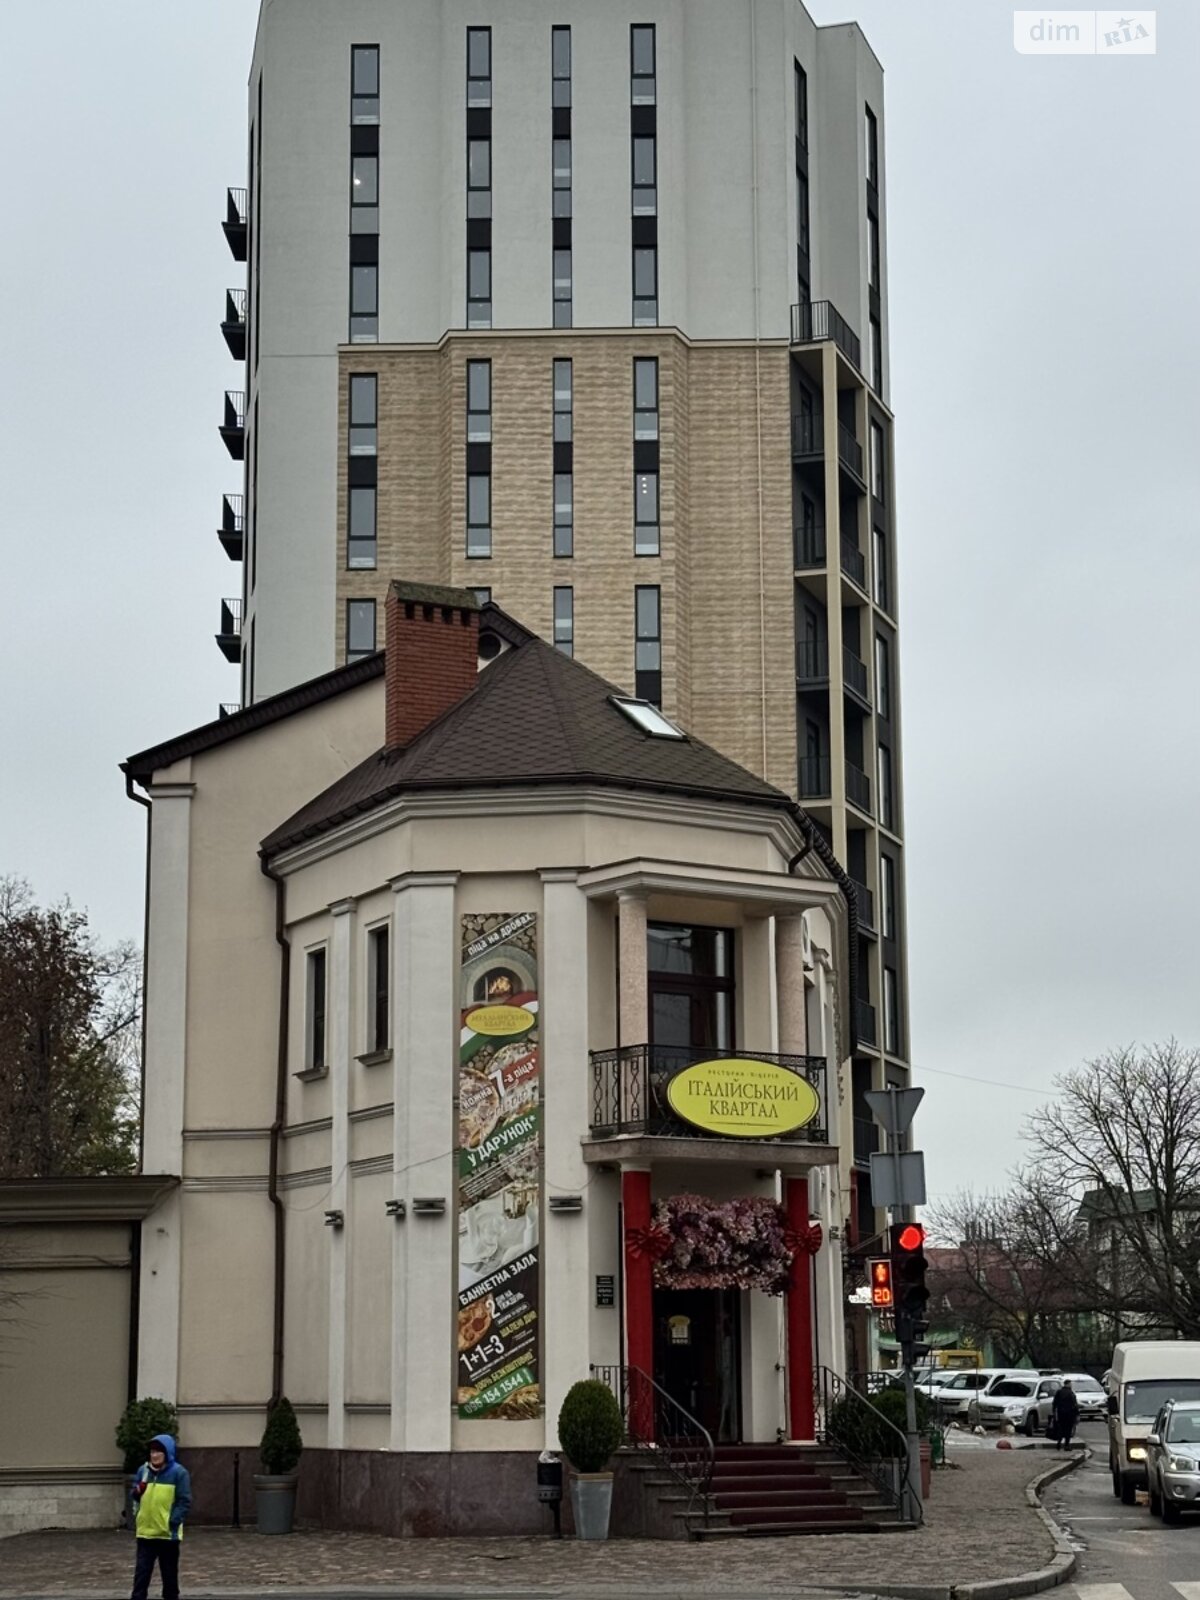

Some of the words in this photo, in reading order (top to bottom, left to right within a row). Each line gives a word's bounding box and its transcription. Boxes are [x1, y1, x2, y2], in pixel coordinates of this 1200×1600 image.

[687, 1078, 799, 1102] ІТАЛІЙСЬКИЙ
[709, 1099, 779, 1119] КВАРТАЛ
[459, 1269, 512, 1305] БАНКЕТНА
[508, 1253, 538, 1276] ЗАЛА
[873, 1287, 891, 1304] 20
[485, 1299, 501, 1320] 2
[459, 1334, 505, 1372] 1+1=3
[482, 1386, 501, 1404] 154
[499, 1373, 525, 1393] 1544
